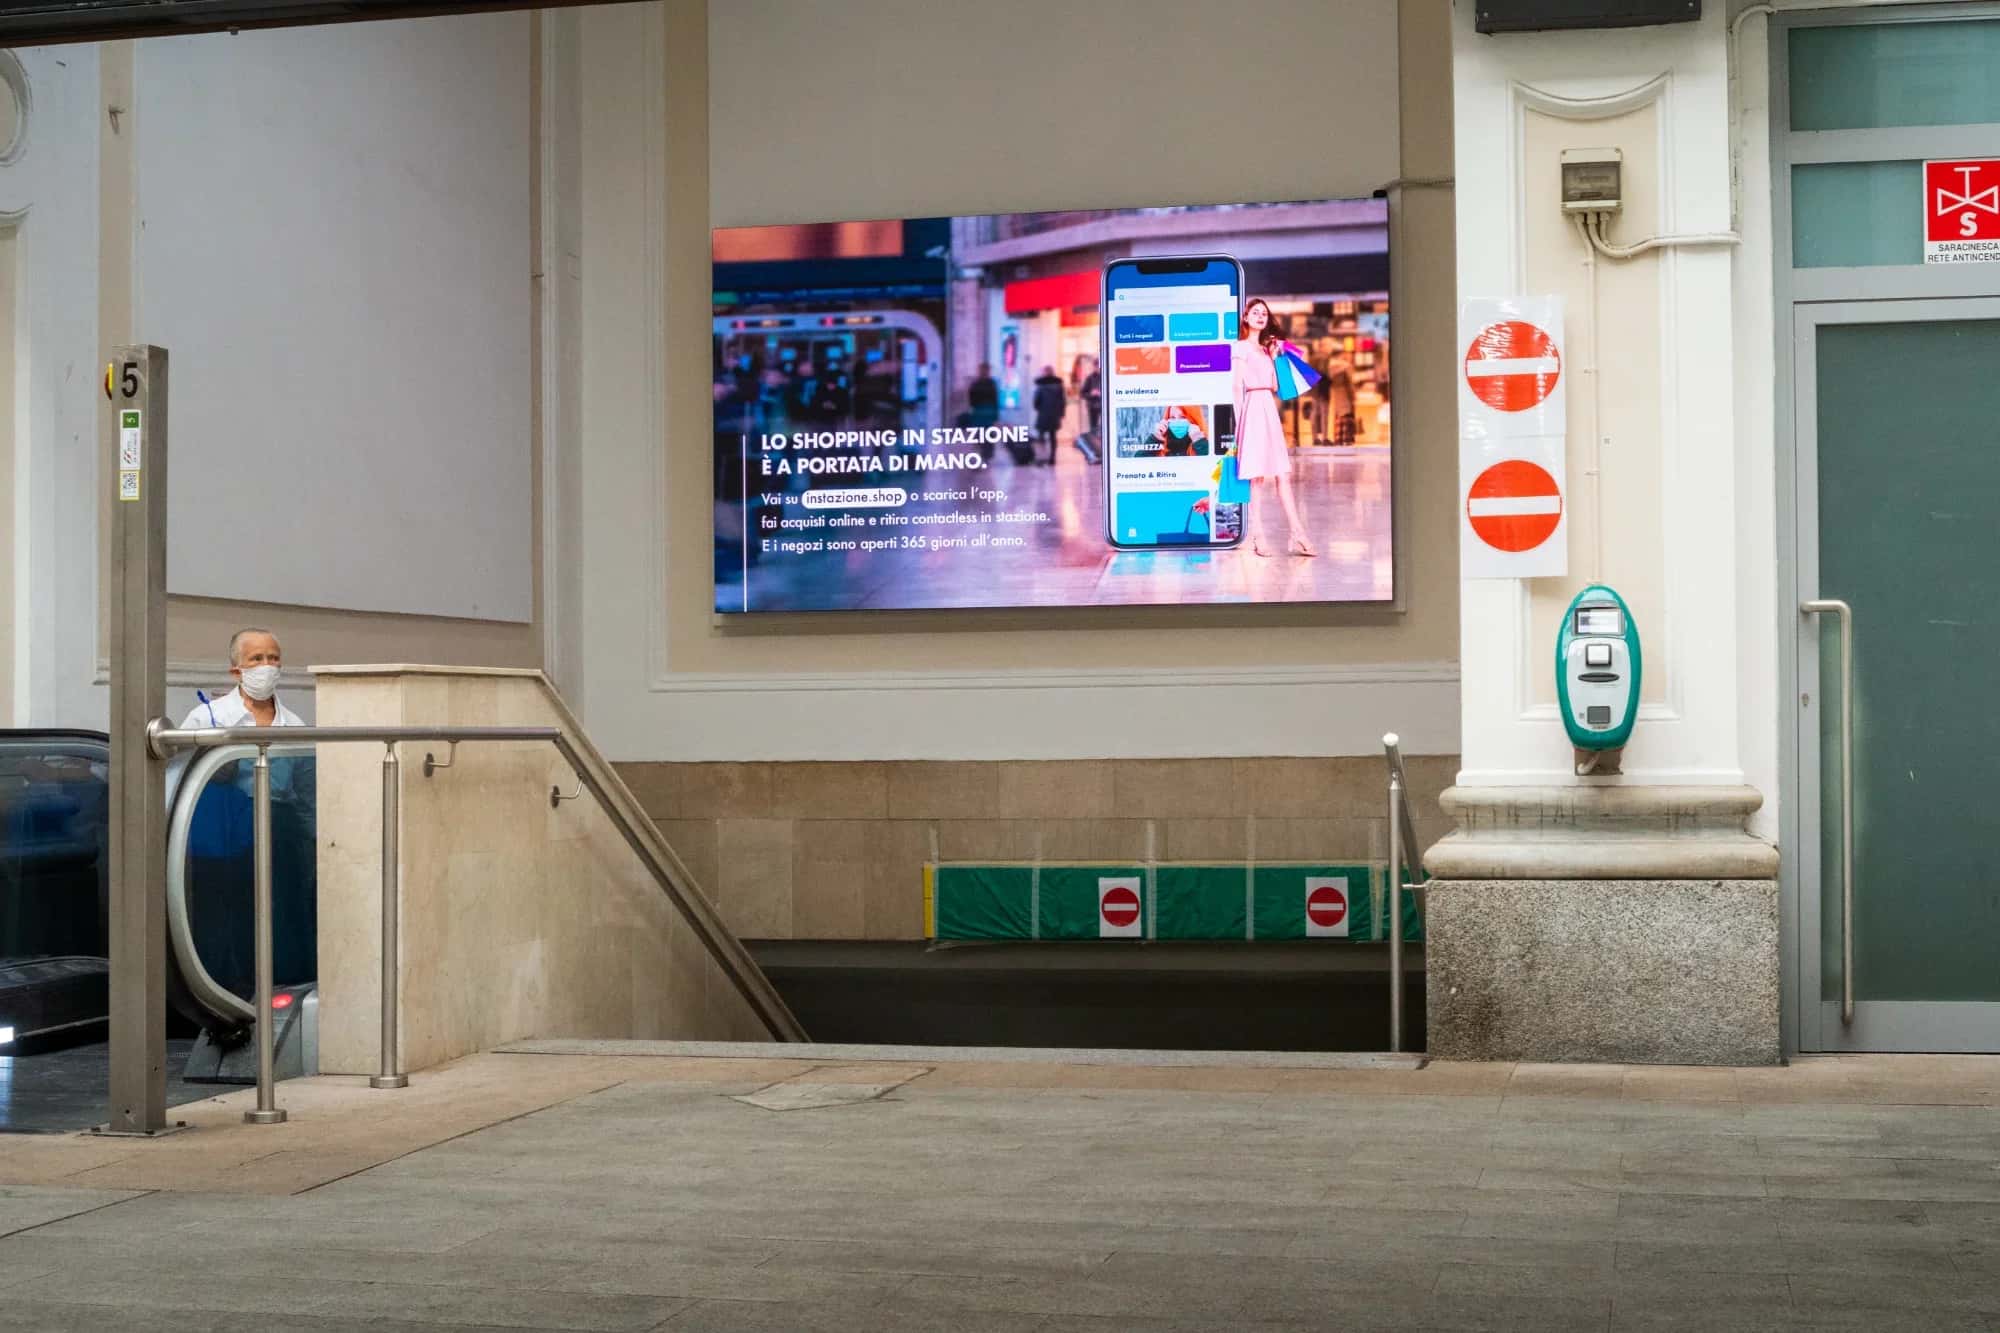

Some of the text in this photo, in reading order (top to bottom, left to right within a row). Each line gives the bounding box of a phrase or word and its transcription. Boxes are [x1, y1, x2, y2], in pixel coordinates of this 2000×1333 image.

[1960, 211, 1977, 237] S
[1938, 243, 1999, 252] SARACINESCA
[1928, 255, 1950, 263] RETE
[121, 362, 138, 398] 5
[761, 426, 1029, 450] LO SHOPPING IN STAZIONE
[761, 453, 988, 476] È A PORTATA DI MANO.
[761, 493, 781, 505] Vai
[785, 495, 798, 505] su
[806, 491, 903, 506] instazione.shop
[911, 493, 919, 501] o
[923, 488, 967, 501] scarica
[761, 510, 1051, 530] fai acquisti online e ritira contactless in stazione.
[762, 540, 770, 552] E
[773, 539, 777, 551] i
[781, 539, 823, 554] negozi
[826, 540, 856, 551] sono
[860, 537, 897, 553] aperti
[901, 536, 926, 549] 365
[930, 535, 968, 551] giorni
